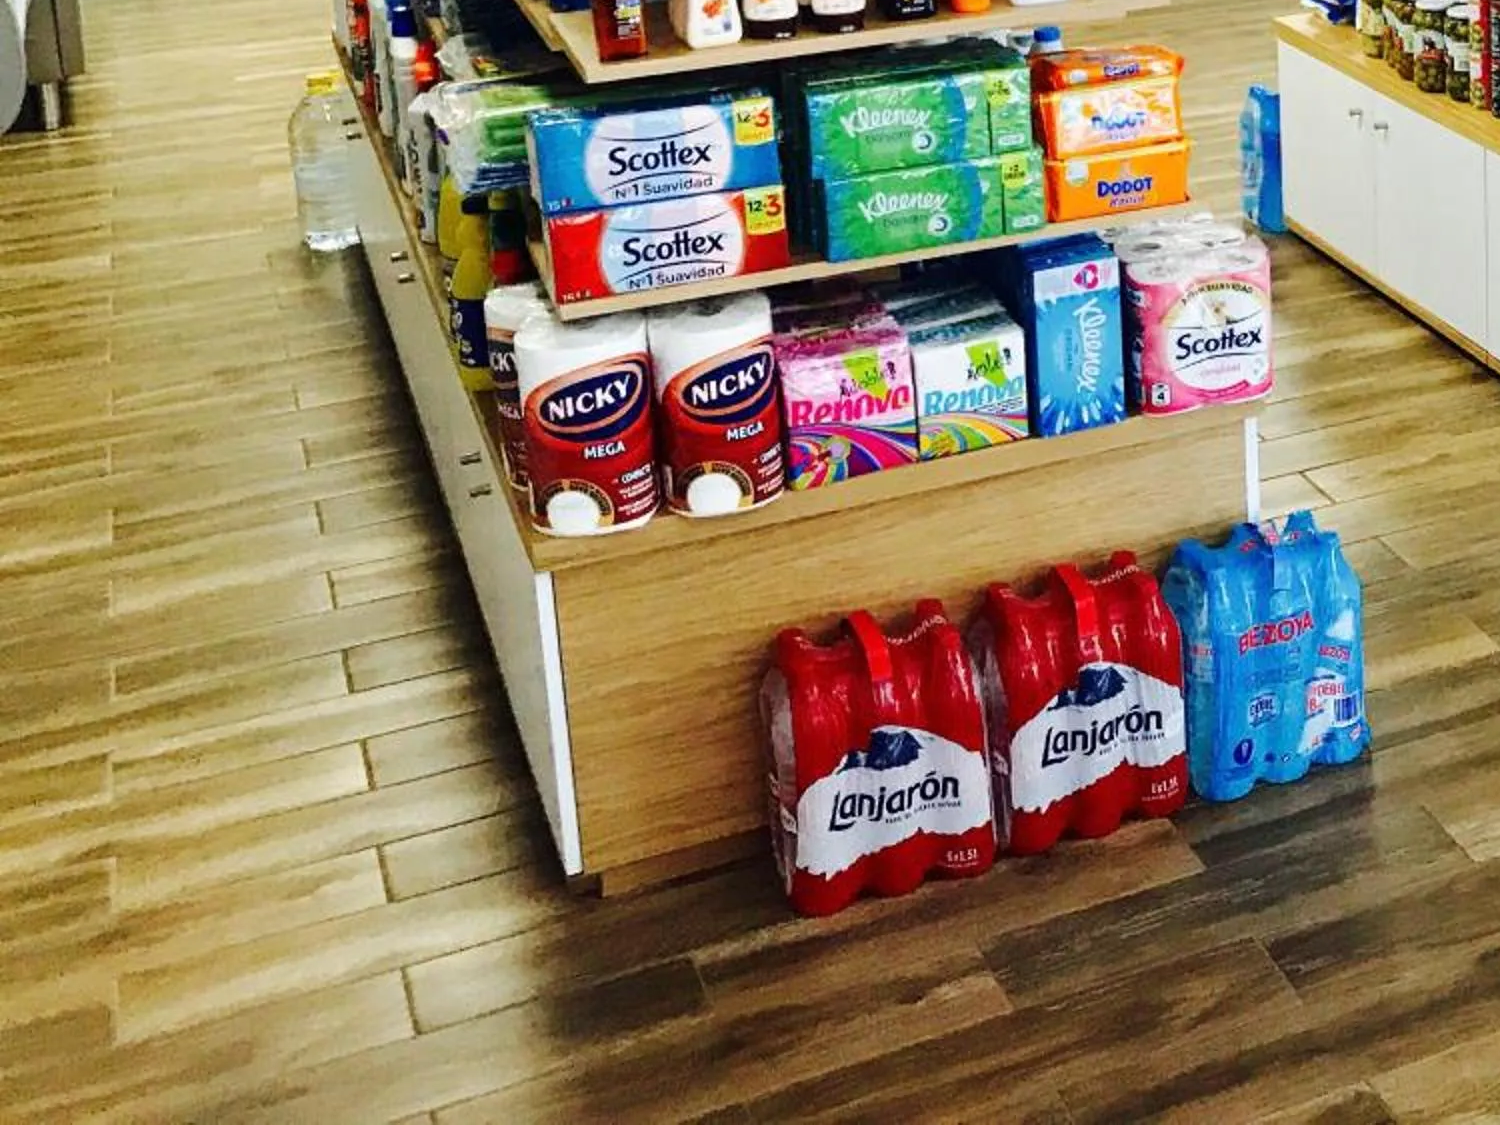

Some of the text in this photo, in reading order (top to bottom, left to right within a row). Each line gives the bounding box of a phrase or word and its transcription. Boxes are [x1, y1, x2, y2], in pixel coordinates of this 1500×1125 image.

[839, 106, 932, 138] Kleenex
[608, 141, 713, 176] Scottex
[643, 175, 714, 196] Suavidad
[1097, 177, 1153, 197] DODOT
[857, 191, 949, 223] Kleenex
[622, 231, 727, 267] Scottex
[656, 263, 726, 285] Suavidad
[1072, 297, 1107, 394] Kleenex
[1175, 327, 1263, 361] Scottex
[547, 374, 631, 422] NICKY
[691, 355, 768, 406] NICKY
[923, 375, 1024, 415] Renova
[791, 384, 911, 426] Renova
[726, 422, 765, 441] MEGA
[583, 440, 626, 460] MEGA
[1239, 610, 1314, 657] BEZOYA
[1041, 704, 1163, 768] Lanjarón
[828, 771, 960, 832] Lanjarón
